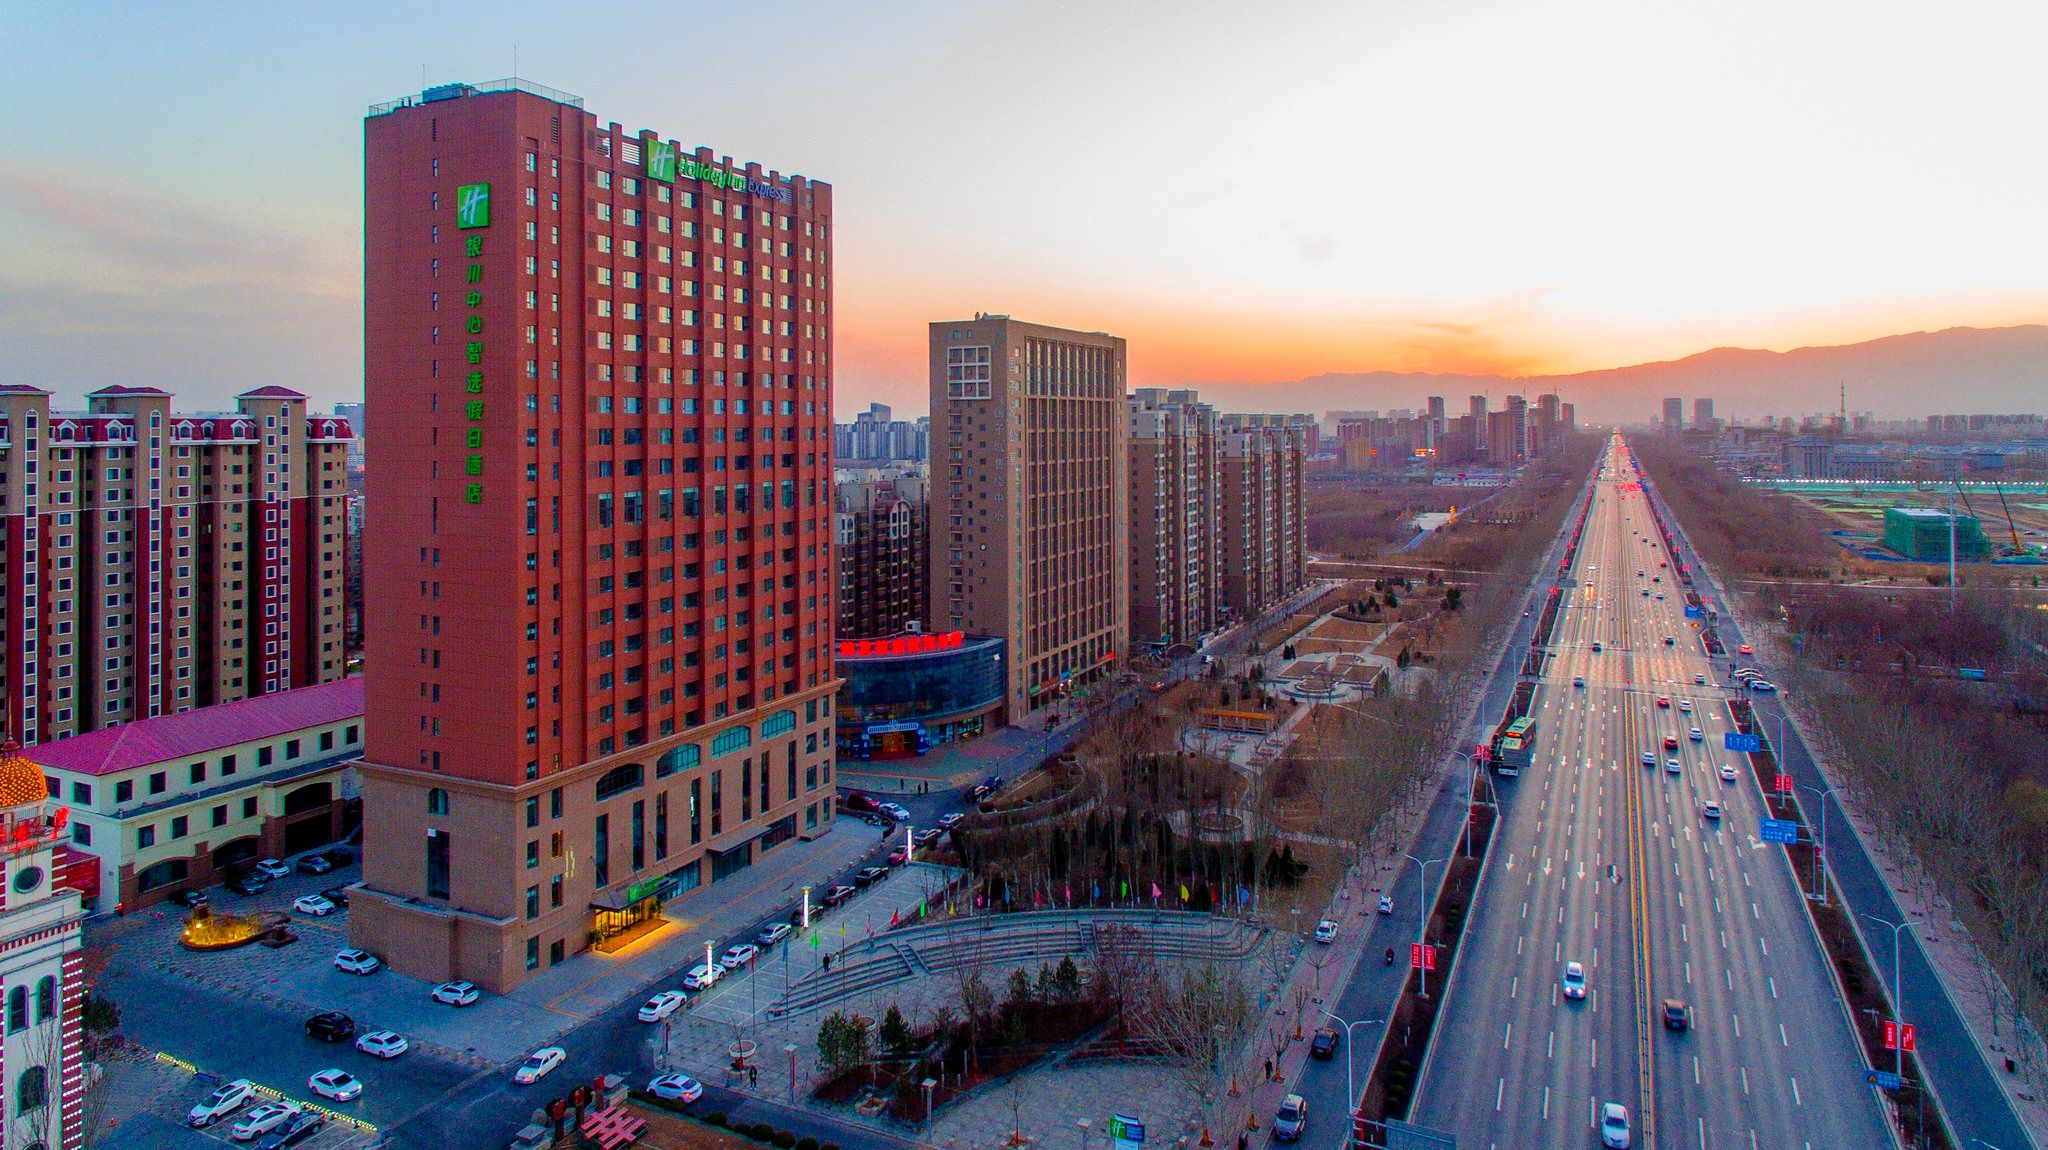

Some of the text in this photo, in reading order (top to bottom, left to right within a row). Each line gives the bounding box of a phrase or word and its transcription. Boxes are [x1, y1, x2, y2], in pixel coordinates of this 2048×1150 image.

[677, 155, 786, 200] Holiday Inn Express
[465, 235, 484, 504] 银川中心智选假日酒店
